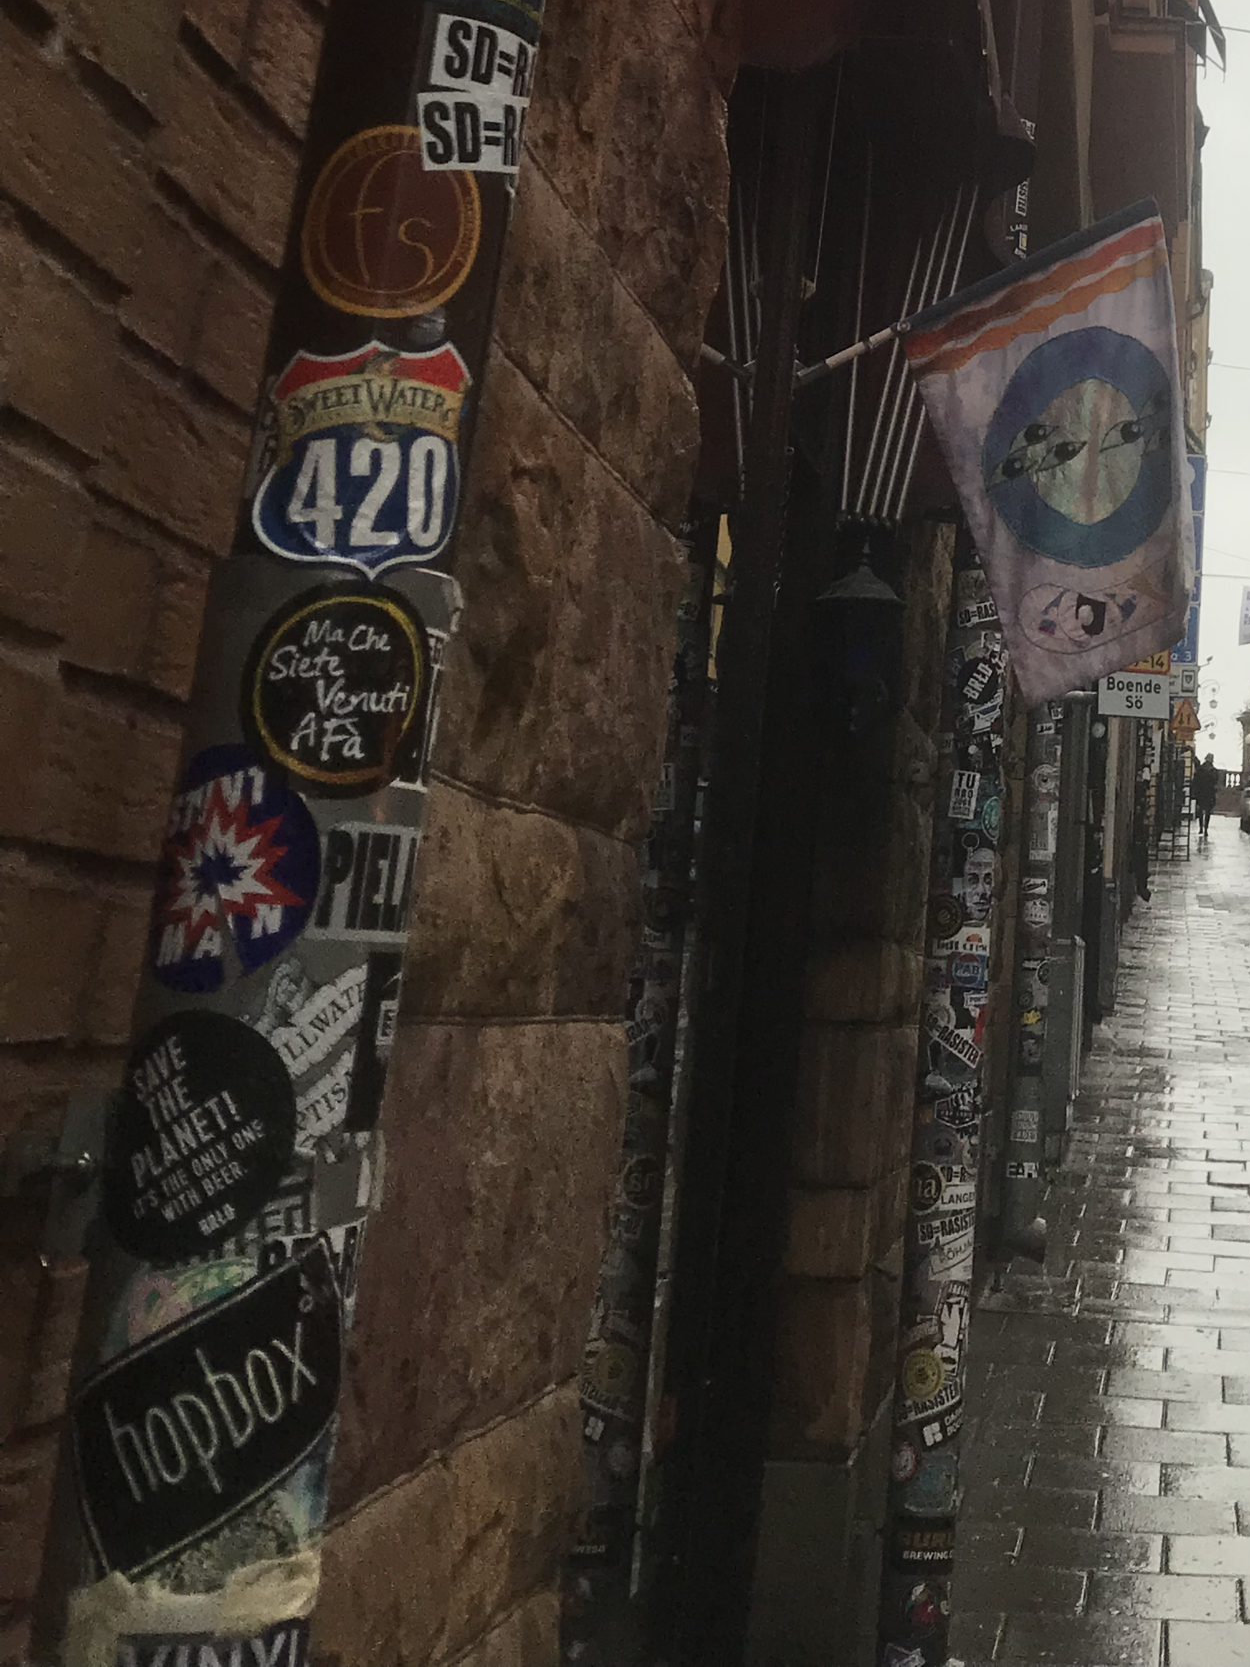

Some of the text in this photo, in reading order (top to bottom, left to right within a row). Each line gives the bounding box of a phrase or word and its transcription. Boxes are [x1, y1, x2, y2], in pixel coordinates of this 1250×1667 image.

[287, 435, 446, 548] 420
[304, 620, 391, 651] Ma Che
[269, 644, 344, 681] Siete
[1133, 654, 1165, 670] -14
[316, 677, 410, 713] Venuti
[1106, 676, 1162, 694] Boende
[1125, 695, 1144, 710] Sö
[291, 712, 318, 751] A
[133, 1036, 187, 1102] SAVE
[148, 1076, 194, 1131] THE
[131, 1091, 242, 1188] PLANET!
[190, 1142, 229, 1178] ONLY
[160, 1191, 203, 1223] WITH
[105, 1322, 317, 1503] hopbox
